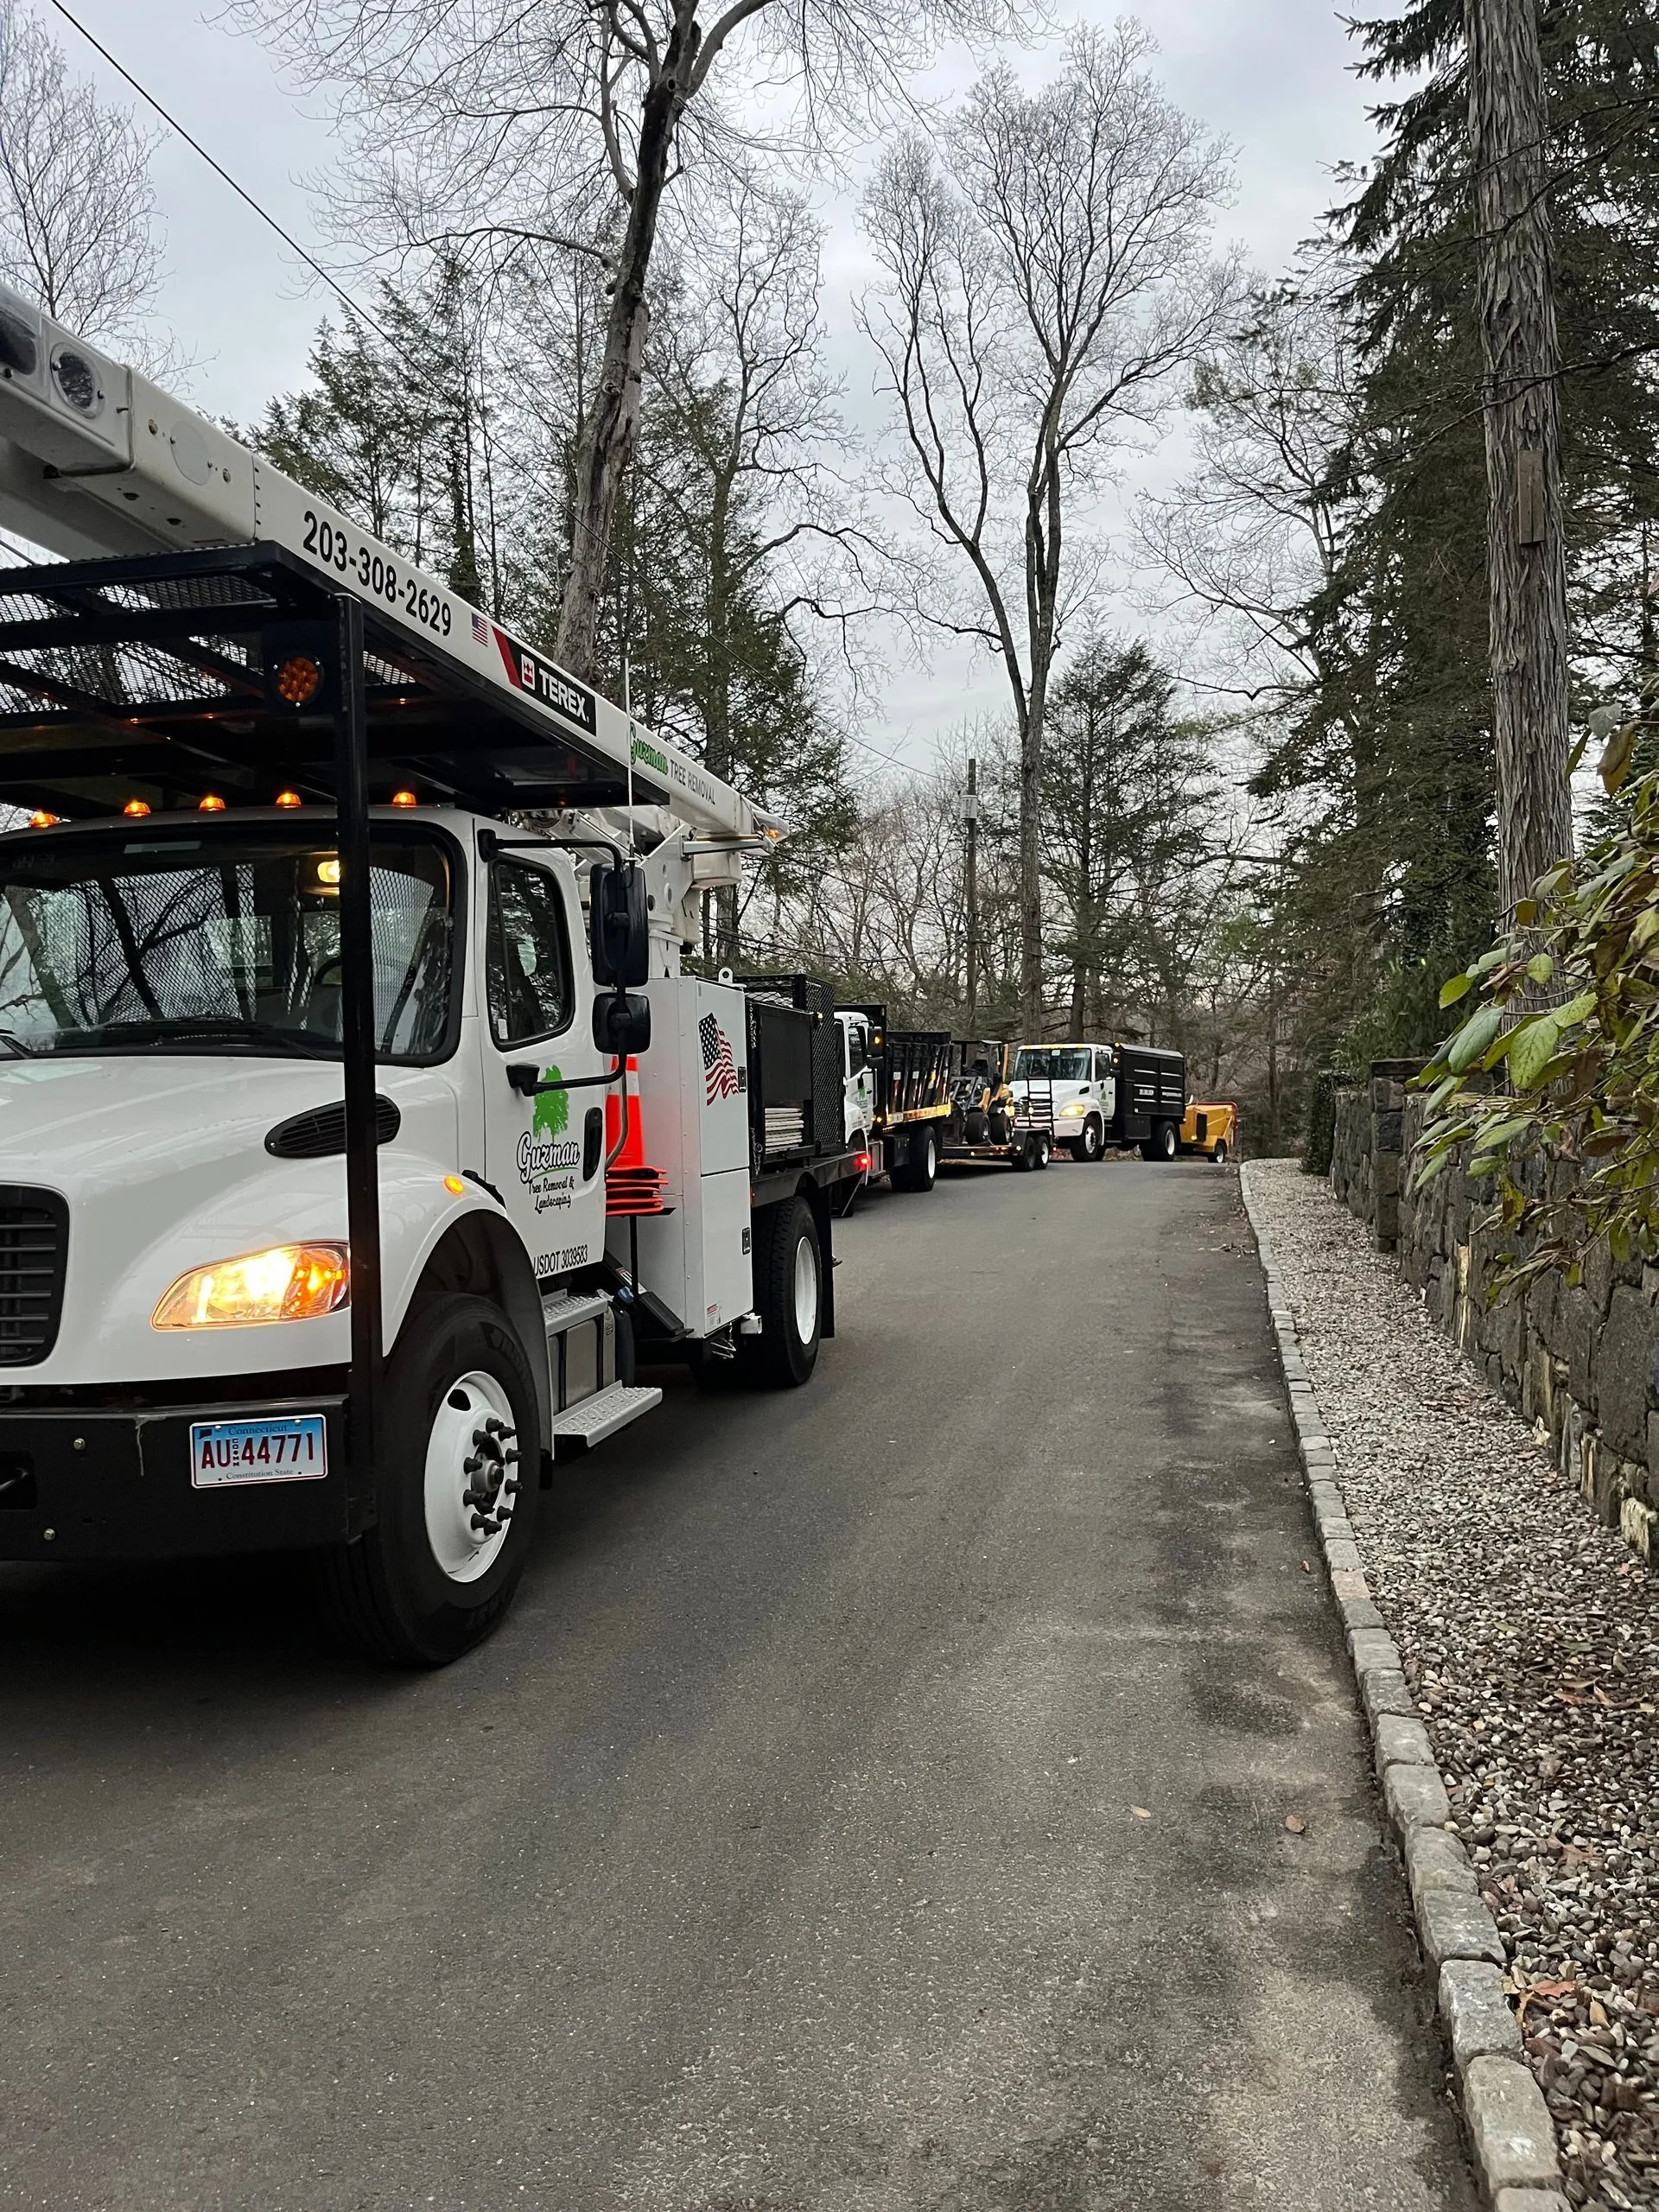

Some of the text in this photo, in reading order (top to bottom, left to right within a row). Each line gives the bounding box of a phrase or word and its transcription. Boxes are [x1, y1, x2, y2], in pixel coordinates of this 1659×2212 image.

[302, 510, 452, 637] 203-308-2629
[627, 721, 716, 805] Guzman TREE REMOVAL
[517, 1131, 580, 1184] Guzman
[528, 1176, 575, 1195] Tree Removal &
[535, 1192, 570, 1214] Landscaping
[533, 1244, 588, 1276] USDOT 3039583
[228, 1425, 288, 1435] Connecticut
[226, 1471, 273, 1480] Constitution
